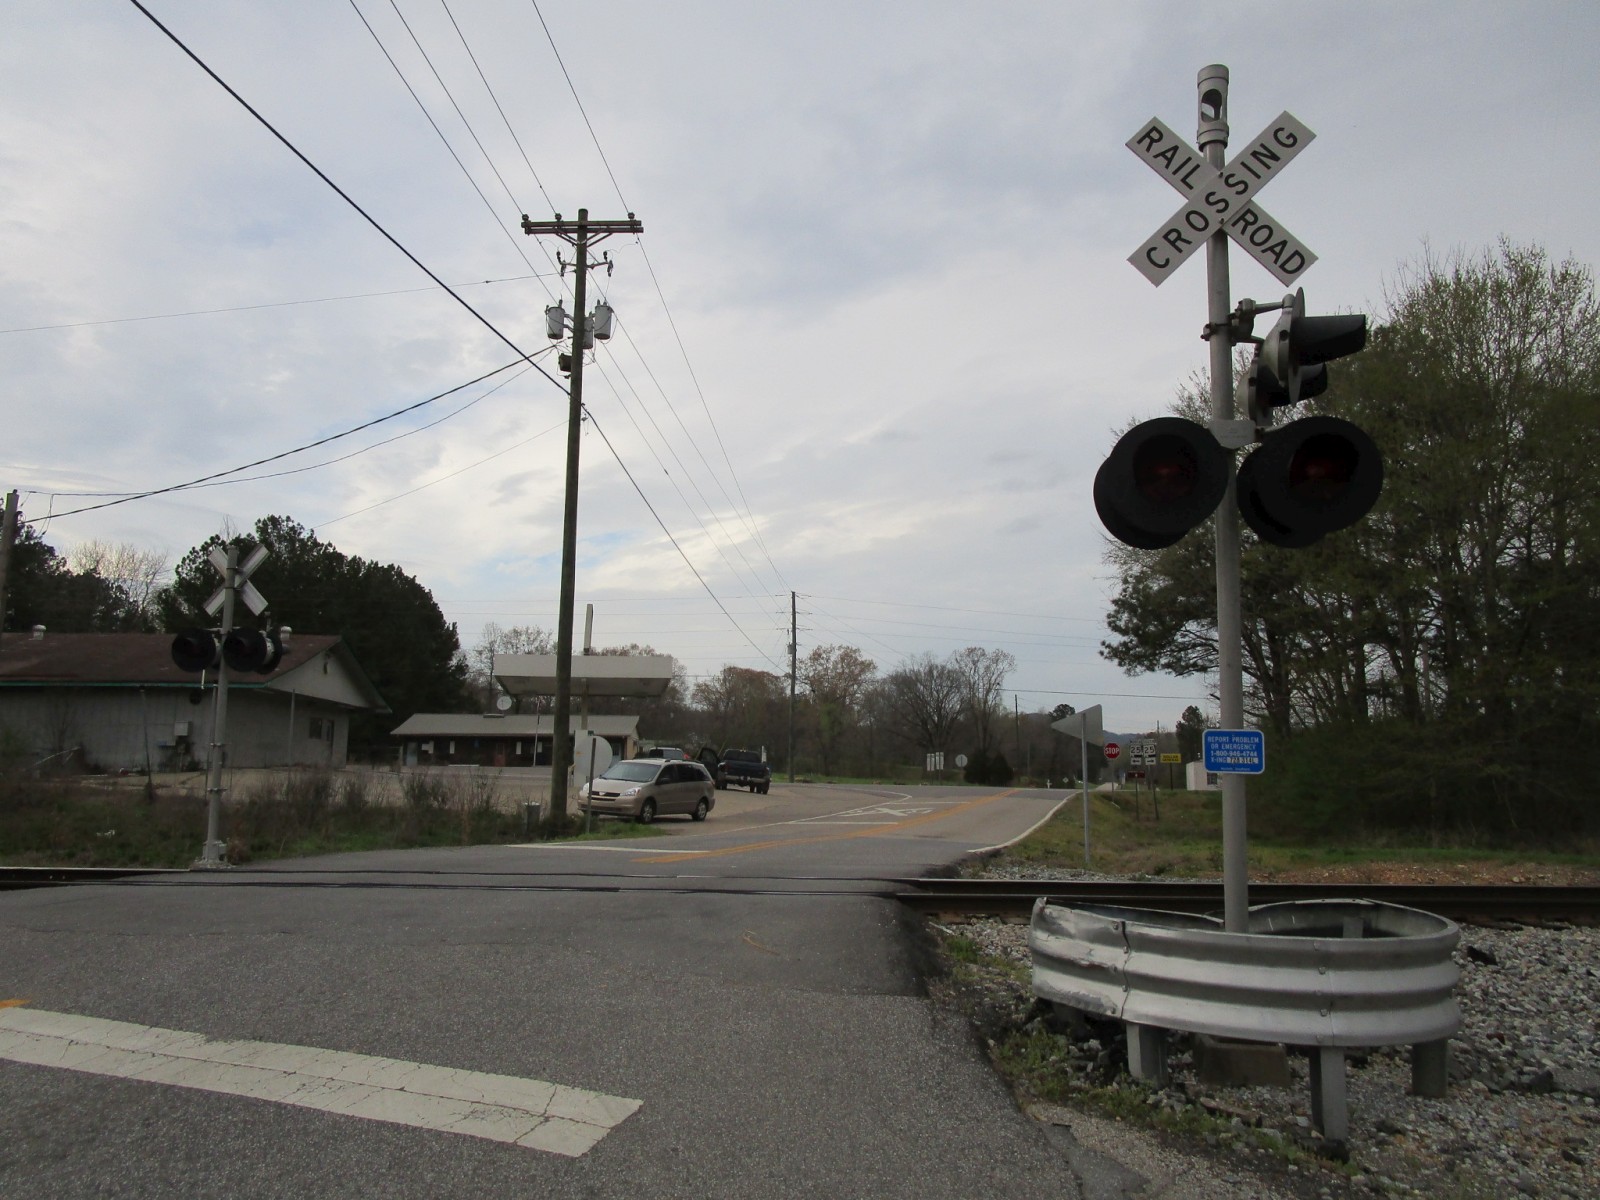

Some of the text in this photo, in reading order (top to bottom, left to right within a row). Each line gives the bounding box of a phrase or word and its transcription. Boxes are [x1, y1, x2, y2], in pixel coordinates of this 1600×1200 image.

[1136, 125, 1306, 275] RAIL ROAD
[1145, 126, 1299, 270] CROSSING
[1104, 747, 1120, 755] STOP
[1130, 746, 1141, 754] 25
[1144, 746, 1155, 754] 25
